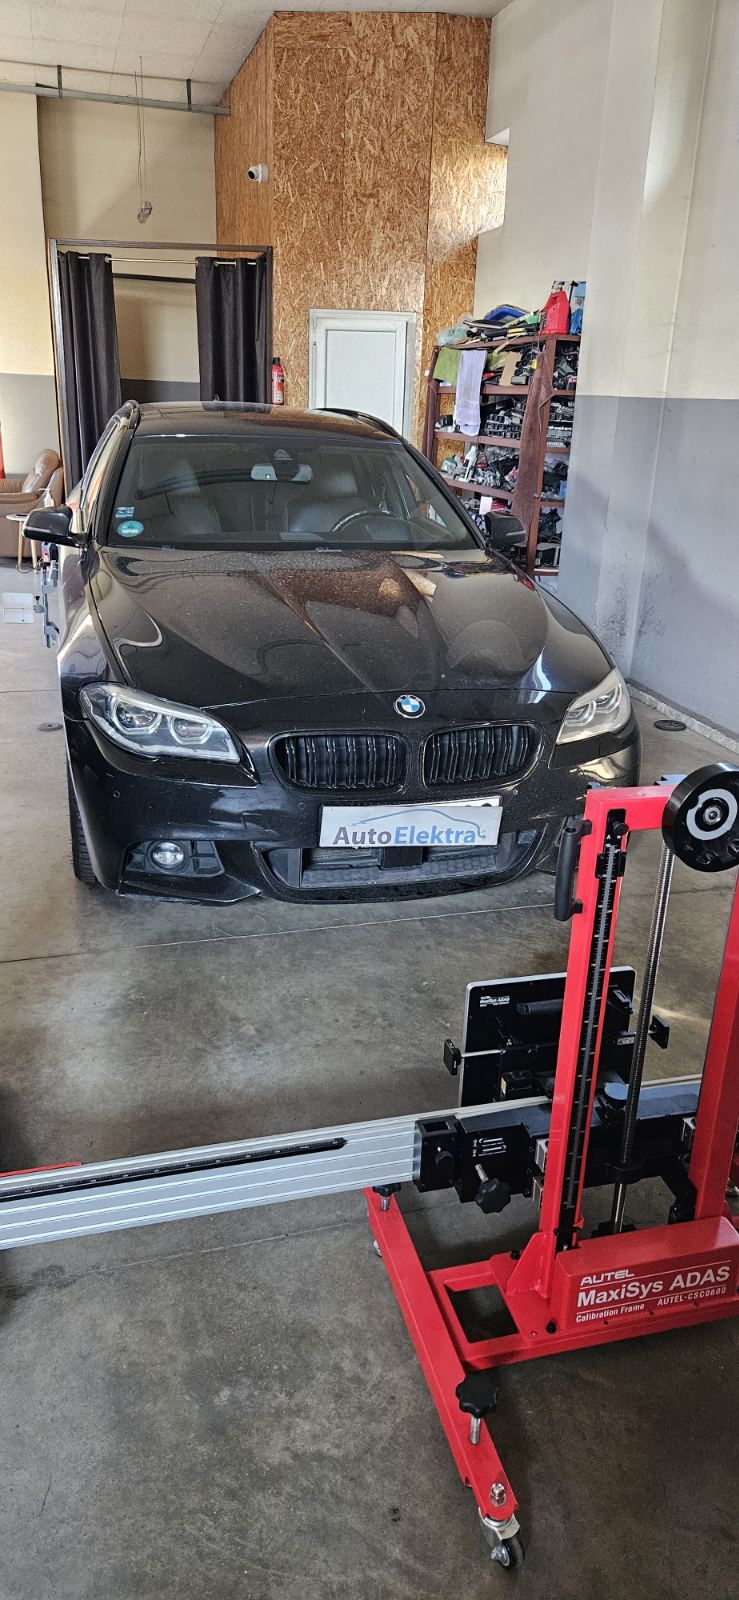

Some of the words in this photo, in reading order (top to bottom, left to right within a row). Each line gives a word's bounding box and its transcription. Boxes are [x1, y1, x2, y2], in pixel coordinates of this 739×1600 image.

[333, 825, 476, 845] AutoElektra
[577, 1280, 664, 1307] MaxiSys
[669, 1266, 730, 1291] ADAS
[581, 1269, 634, 1286] AUTEL
[576, 1309, 618, 1323] Calibration
[620, 1303, 645, 1315] Frame
